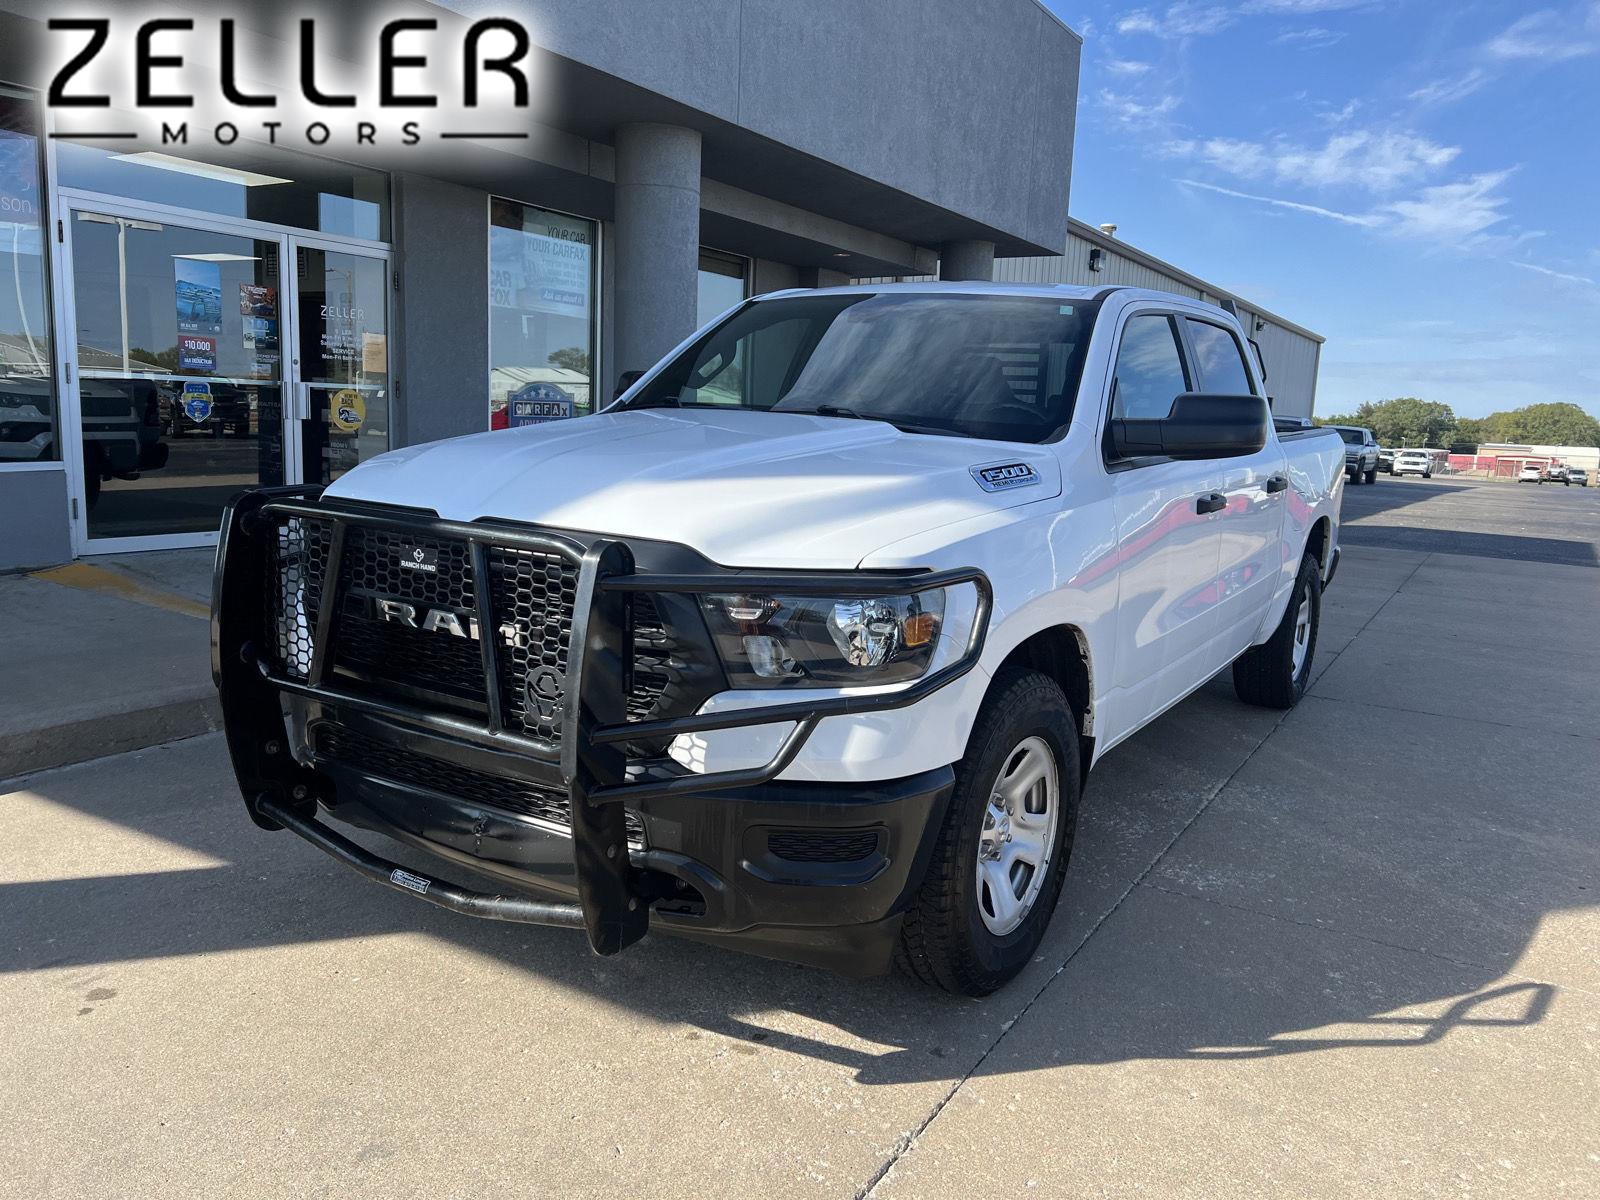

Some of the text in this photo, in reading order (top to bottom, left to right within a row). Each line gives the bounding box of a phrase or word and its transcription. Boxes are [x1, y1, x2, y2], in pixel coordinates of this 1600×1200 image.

[547, 225, 569, 241] YOUR
[527, 237, 586, 261] YOUR CARFAX
[320, 305, 365, 320] ZELLER
[515, 403, 569, 416] CARFAX
[981, 465, 1029, 481] 1500
[401, 560, 436, 572] RANCH HAND
